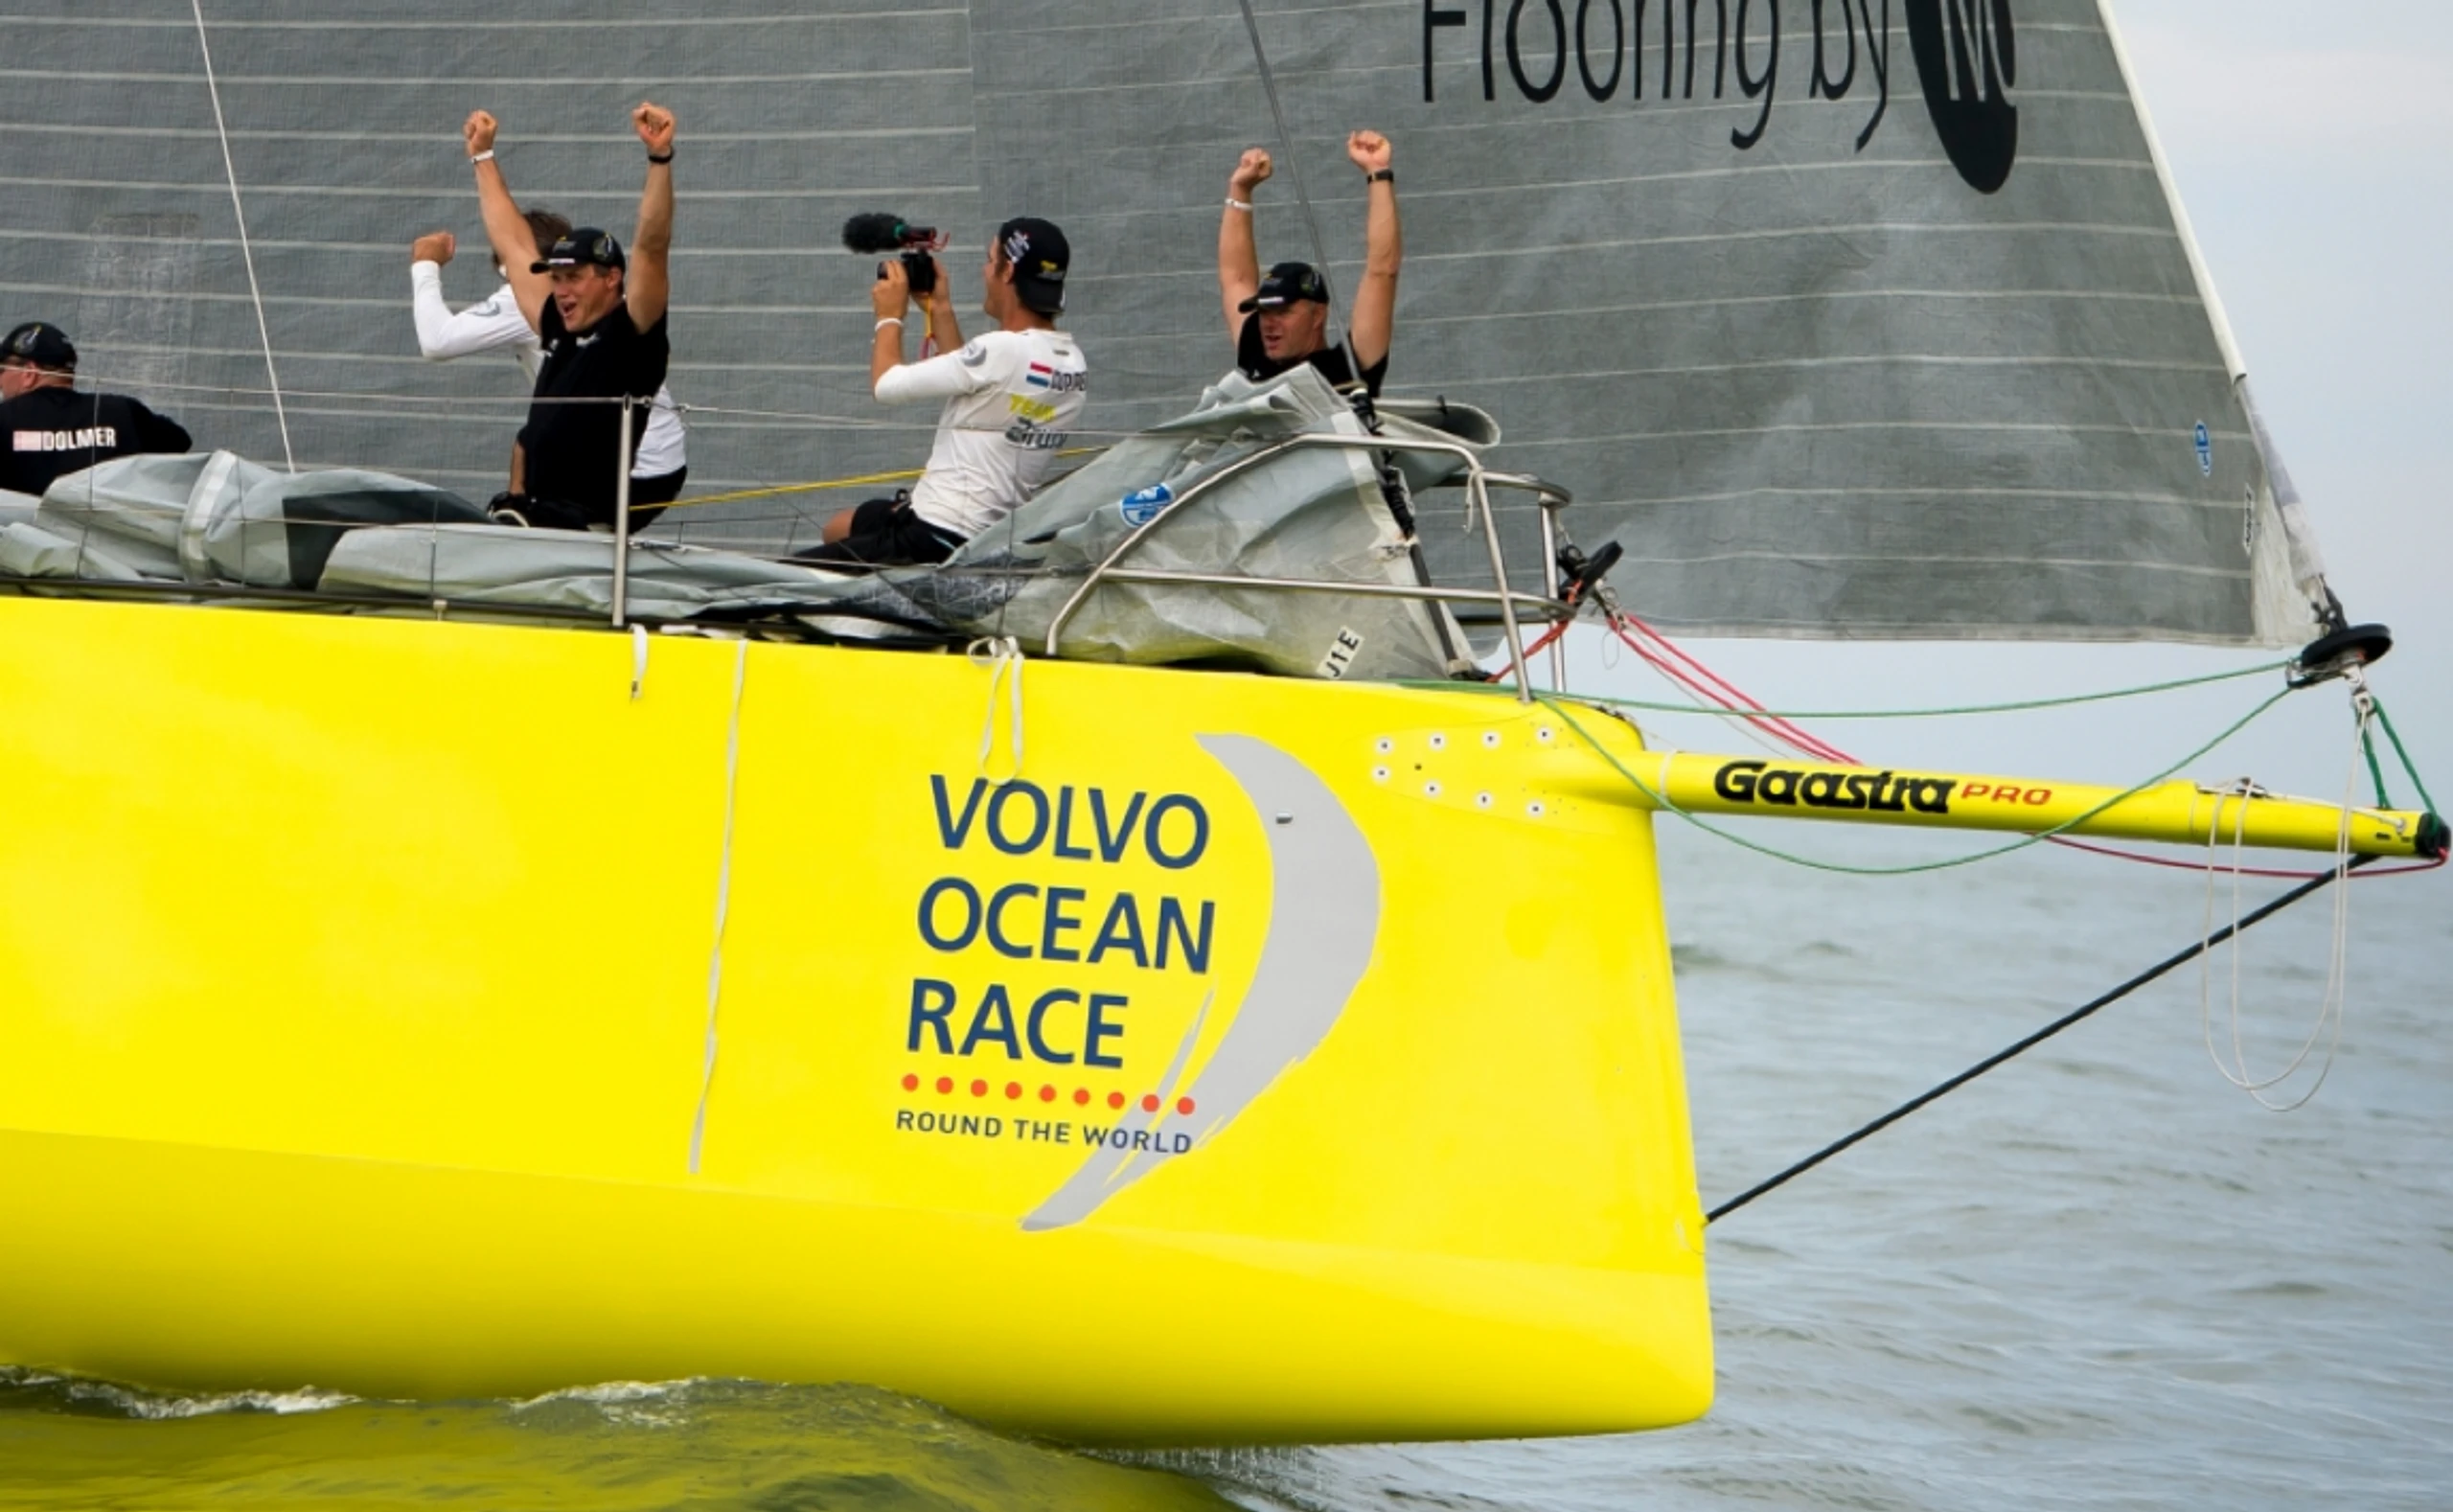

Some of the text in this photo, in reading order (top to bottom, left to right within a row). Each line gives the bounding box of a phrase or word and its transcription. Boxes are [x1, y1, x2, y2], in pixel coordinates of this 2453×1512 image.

[1422, 0, 1889, 152] Flooring by
[42, 426, 116, 450] DOLMER
[930, 774, 1210, 869] VOLVO
[1713, 761, 2053, 814] Gaastra PRO
[917, 876, 1216, 974] OCEAN
[906, 977, 1130, 1069] RACE
[896, 1110, 1193, 1156] ROUND THE WORLD
